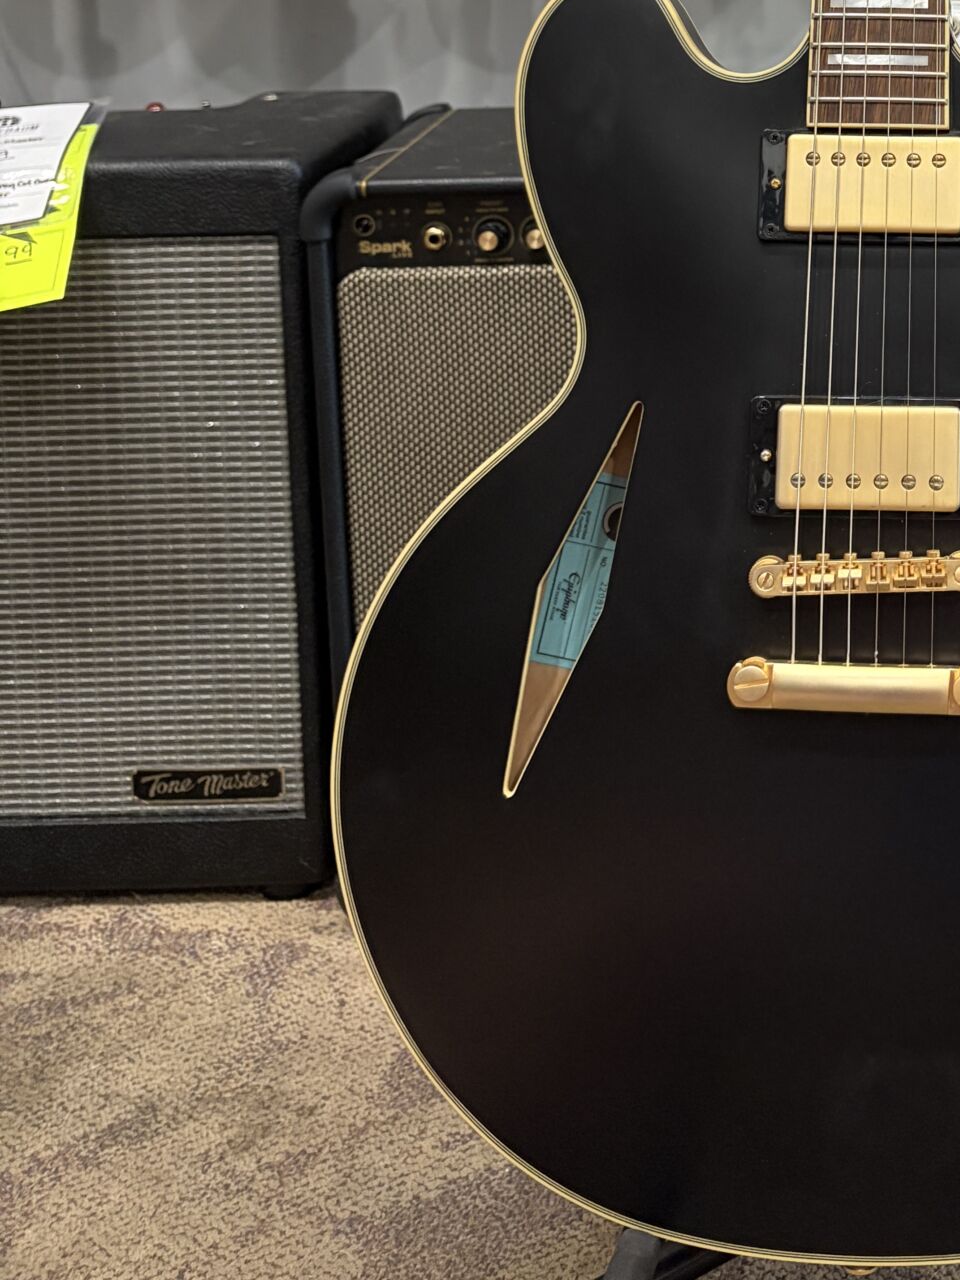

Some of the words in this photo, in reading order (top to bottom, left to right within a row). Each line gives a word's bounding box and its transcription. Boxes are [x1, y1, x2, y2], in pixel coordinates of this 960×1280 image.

[358, 240, 411, 256] Spark
[556, 572, 581, 621] Epiphone
[140, 773, 194, 797] Tone
[197, 771, 269, 796] Master
